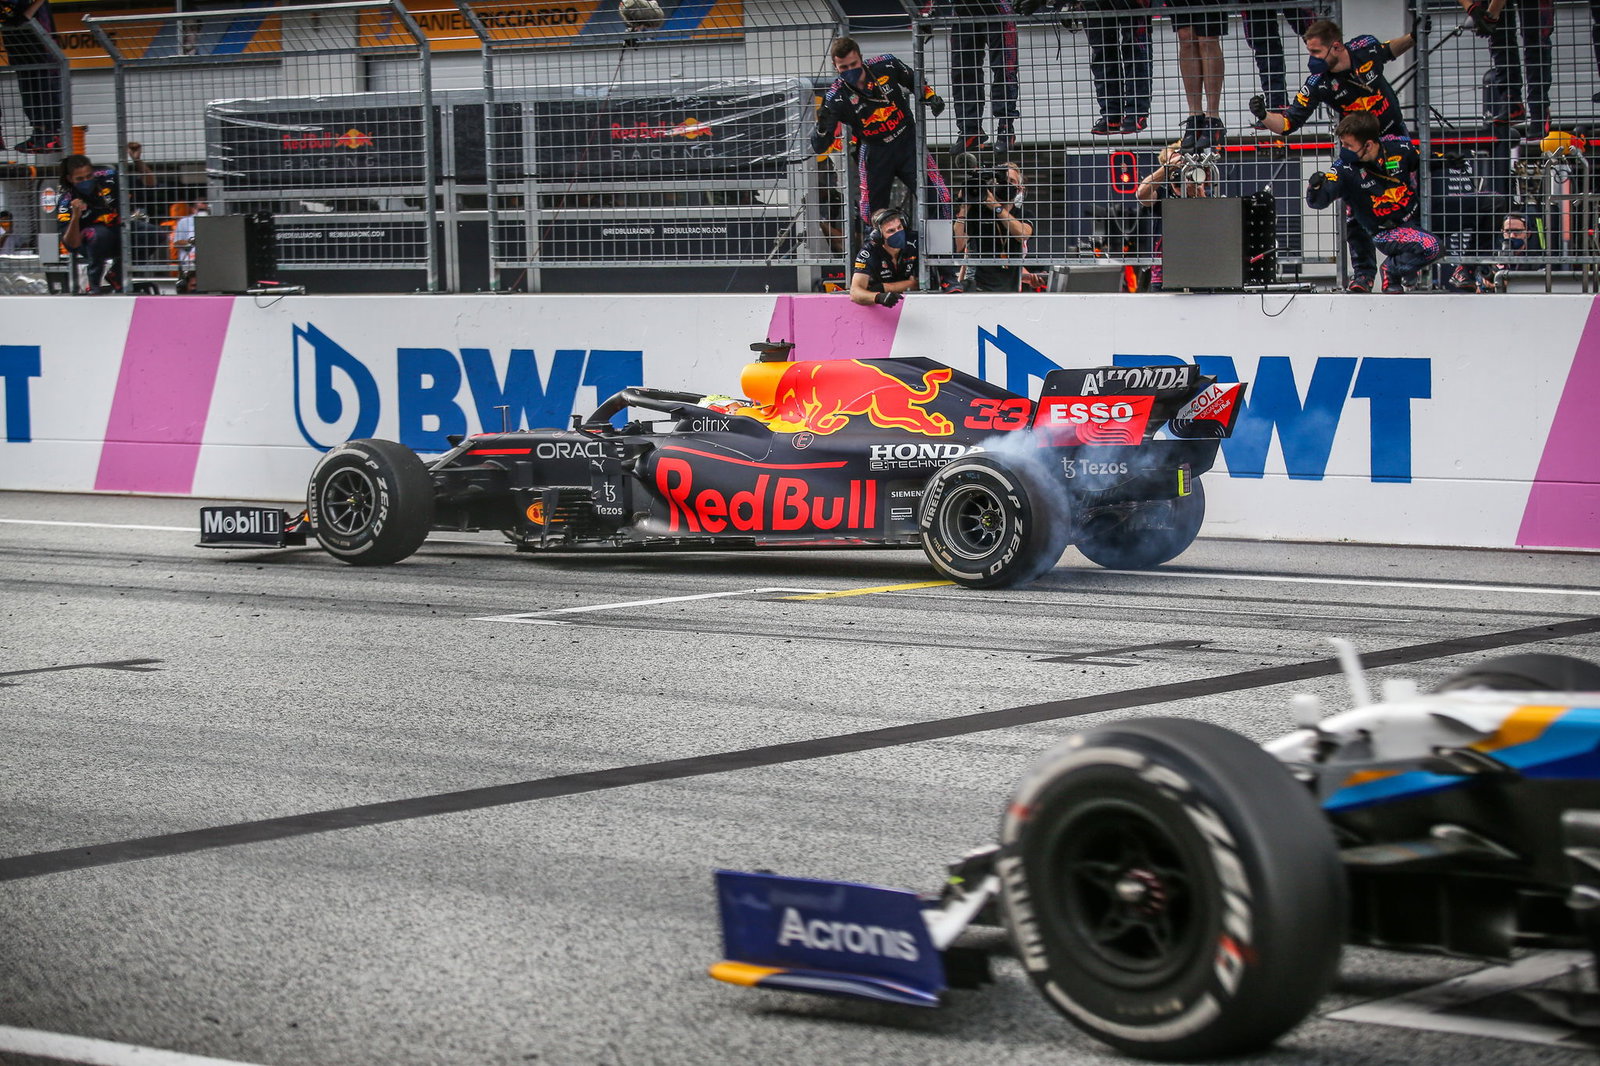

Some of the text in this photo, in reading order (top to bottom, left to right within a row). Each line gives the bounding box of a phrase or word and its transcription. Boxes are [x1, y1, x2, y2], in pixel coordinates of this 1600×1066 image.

[412, 7, 578, 31] ANIEL RICCIARDO
[862, 123, 887, 136] Red
[886, 109, 905, 131] Bull
[662, 226, 728, 235] REDBULLRACNG.COM
[397, 348, 643, 454] BWT
[1050, 402, 1133, 424] ESSO
[1191, 385, 1223, 413] COLA
[692, 415, 730, 432] citrix
[963, 397, 1032, 431] 33
[1113, 354, 1431, 484] WT
[1079, 458, 1128, 475] Tezos
[373, 476, 389, 537] ZERO
[596, 504, 623, 515] Tezos
[655, 457, 877, 534] Red Bull
[922, 479, 946, 529] PIRELLI
[204, 510, 260, 534] Mobil
[990, 494, 1023, 576] P ZERO
[777, 907, 919, 963] Acronis
